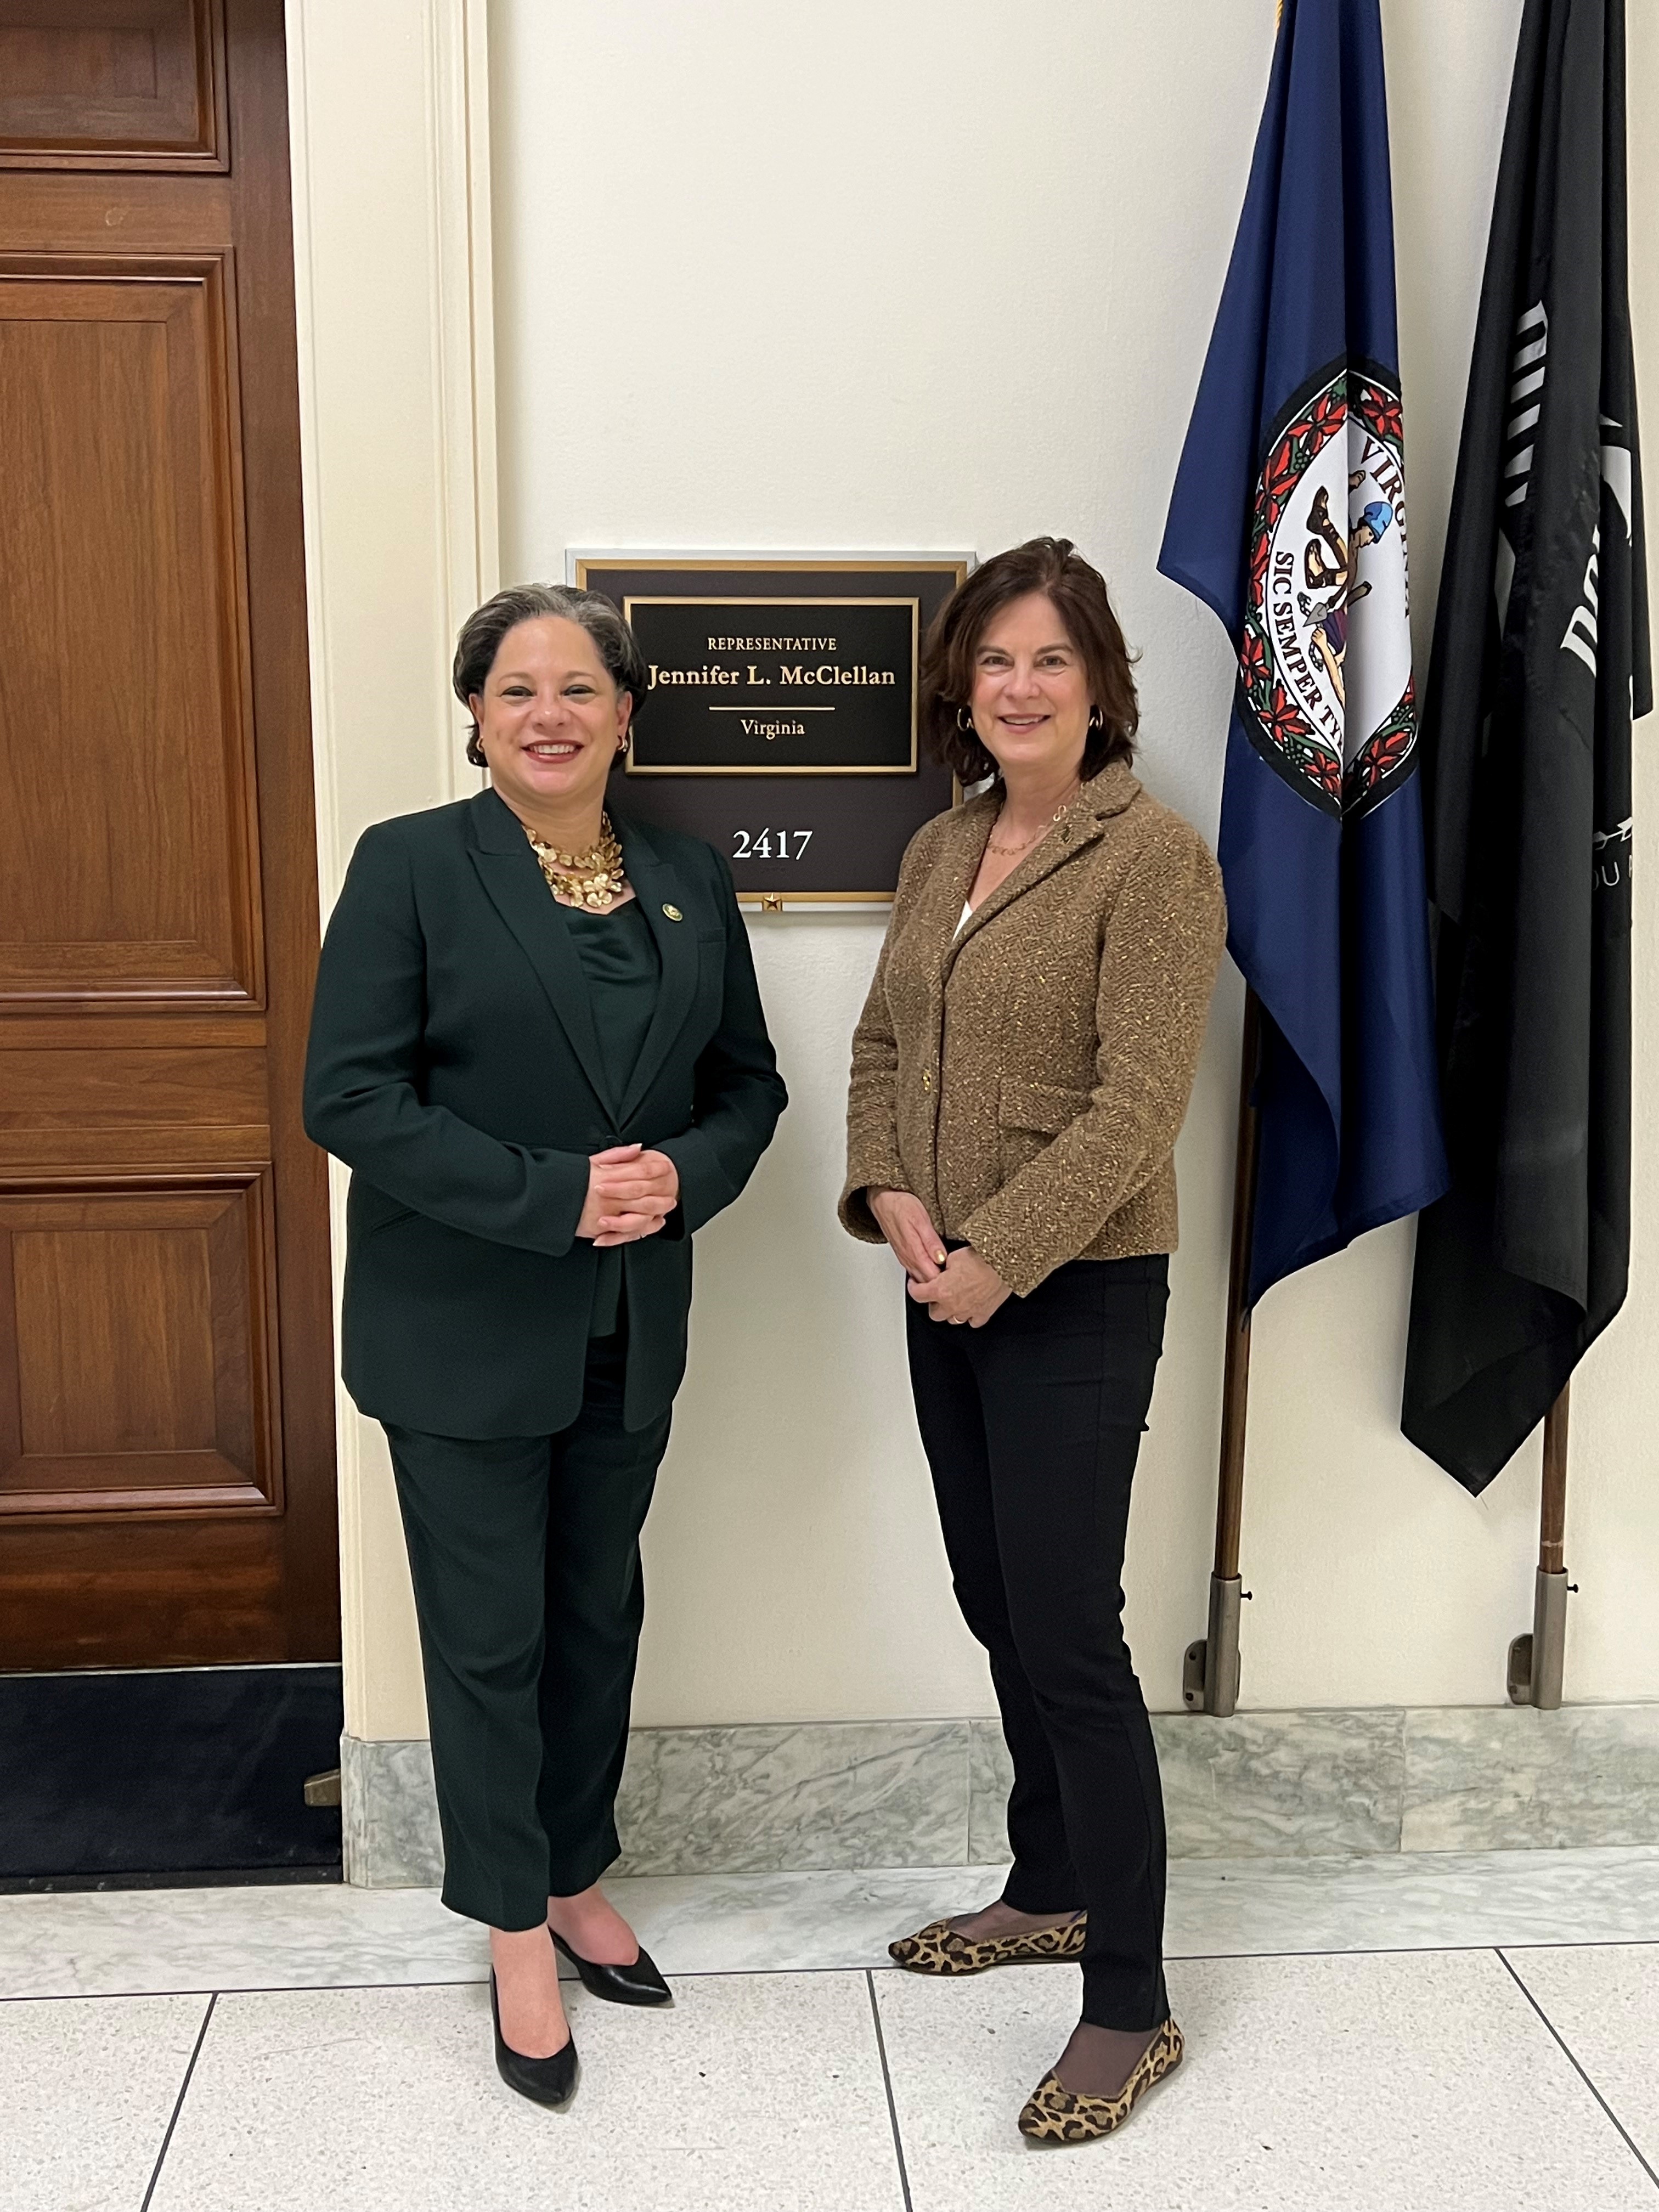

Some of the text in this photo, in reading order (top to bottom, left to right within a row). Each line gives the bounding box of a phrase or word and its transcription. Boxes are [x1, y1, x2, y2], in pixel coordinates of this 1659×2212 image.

[1272, 551, 1295, 595] SIC
[708, 637, 837, 651] REPRESENTATIVE
[1273, 602, 1323, 711] SEMPER
[647, 664, 896, 690] Jennifer L. McClellan
[741, 719, 805, 740] Virginia
[732, 827, 813, 860] 2417
